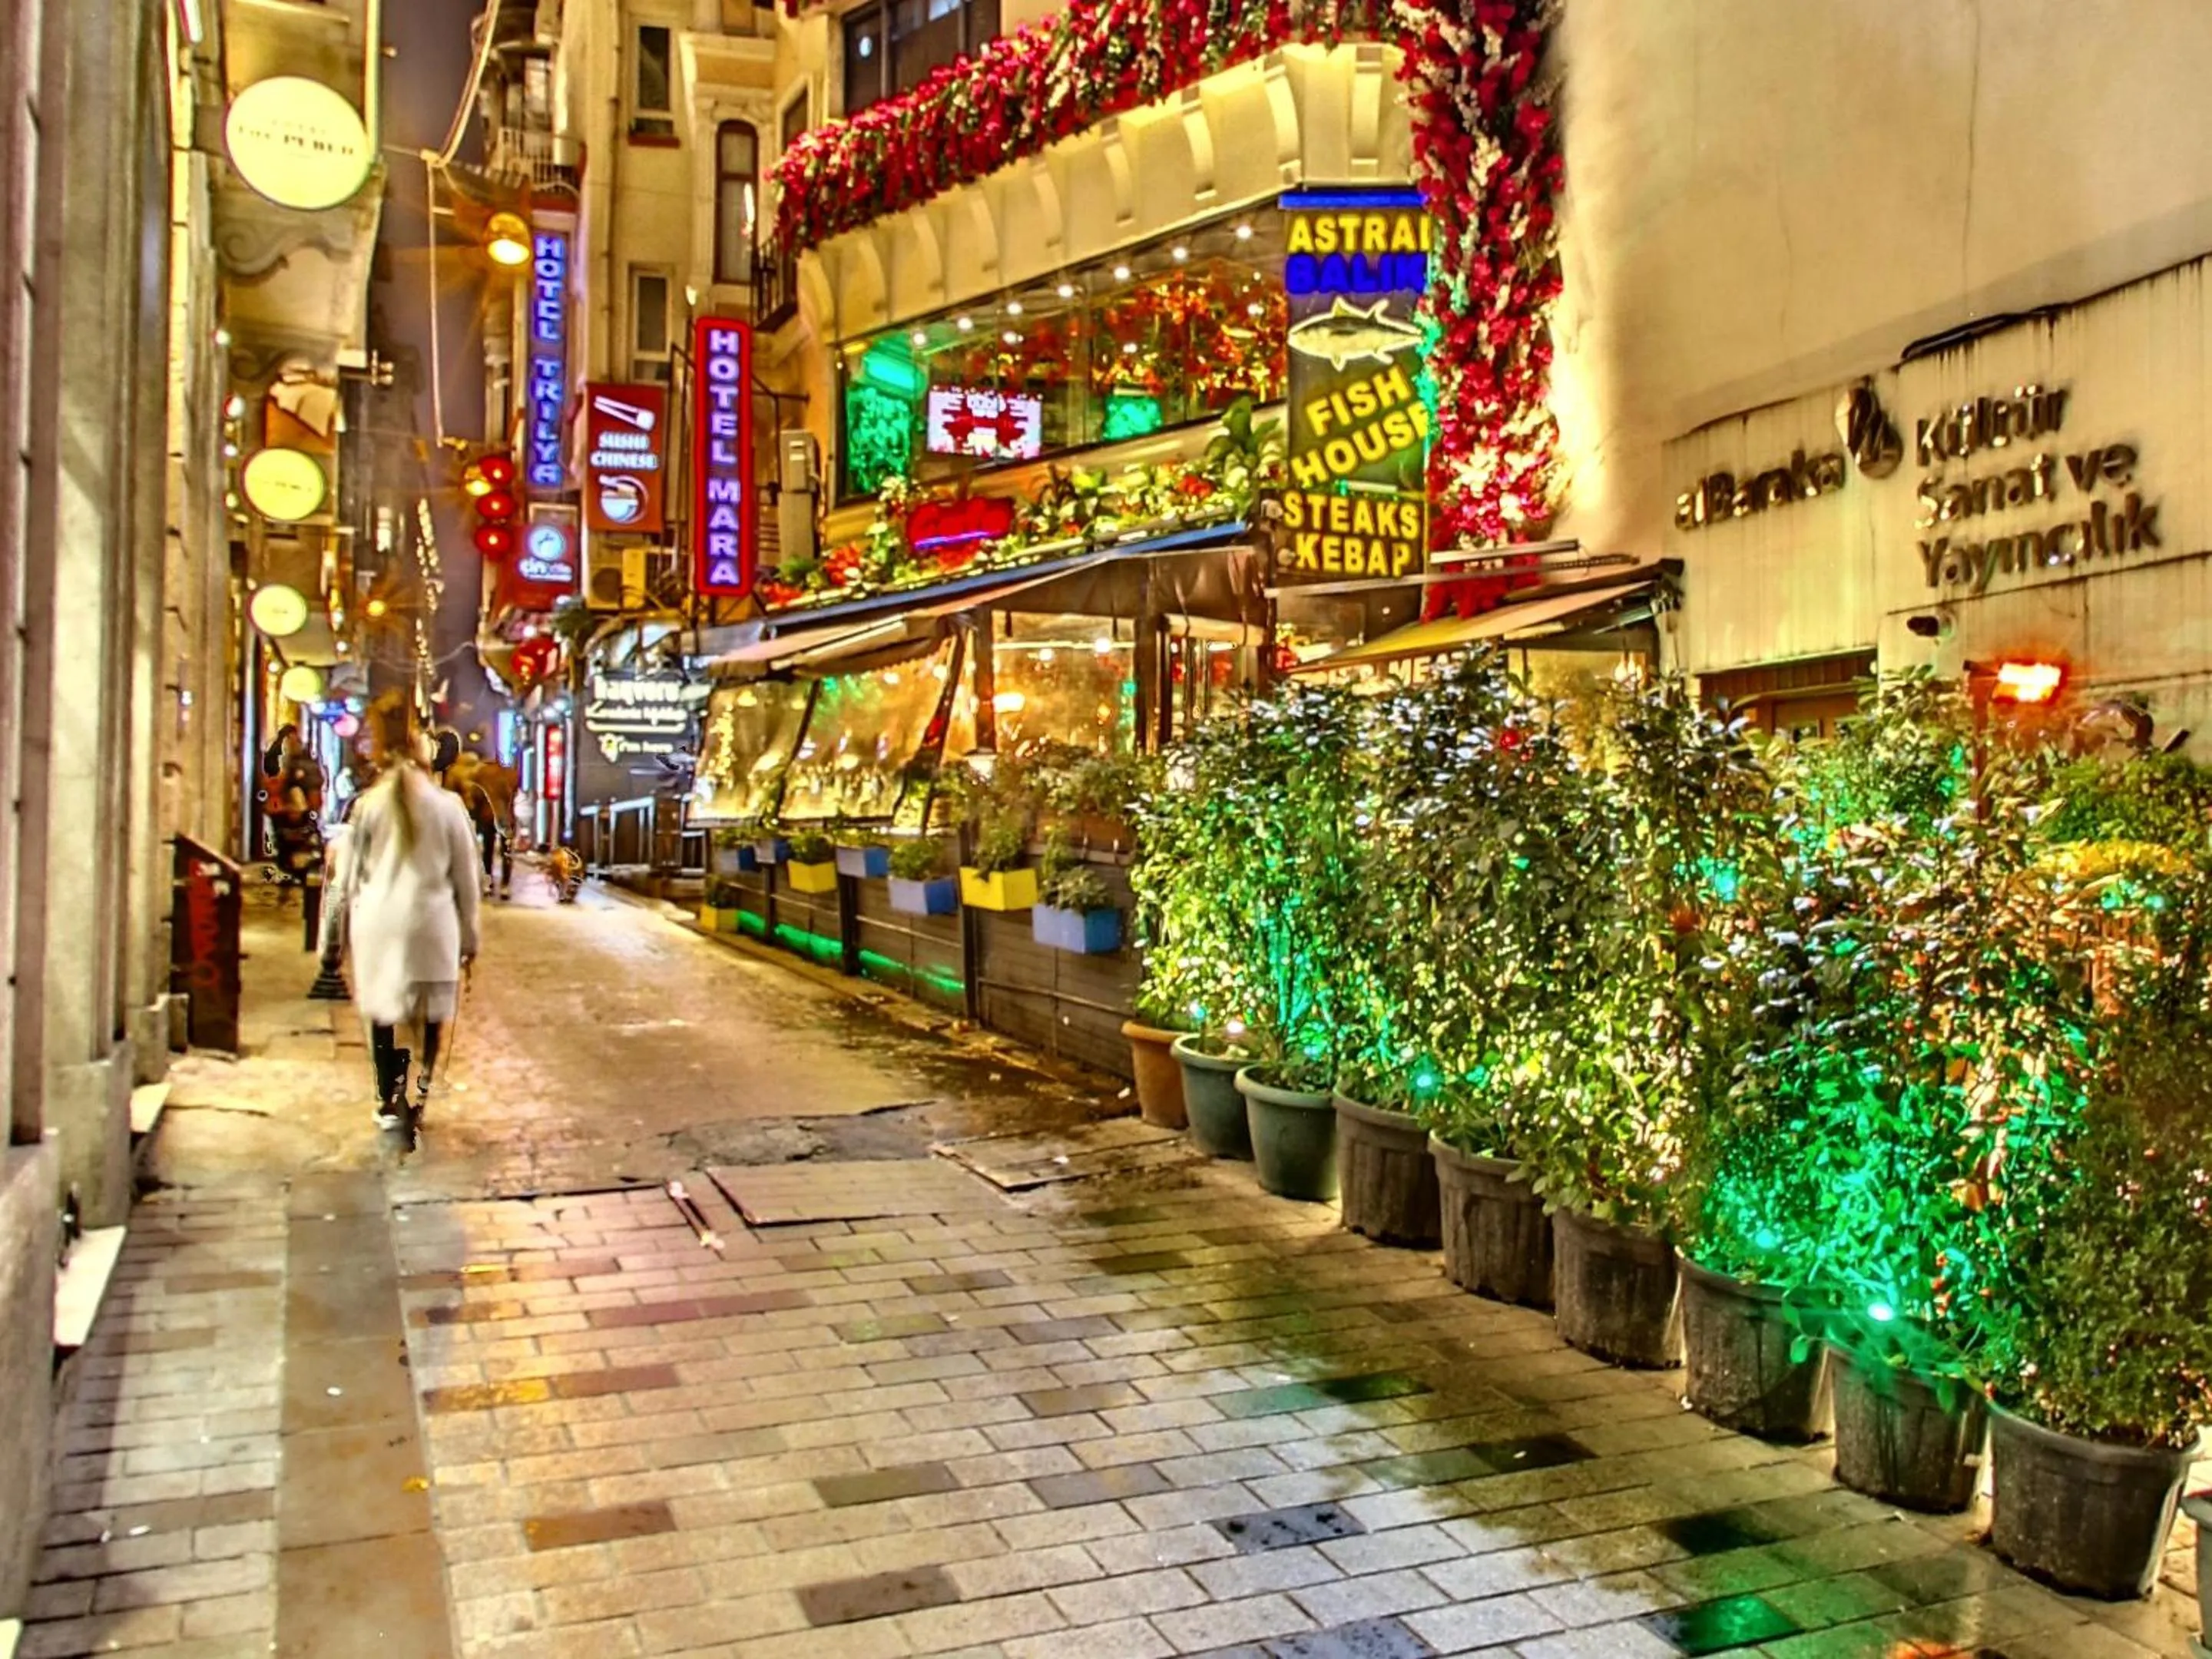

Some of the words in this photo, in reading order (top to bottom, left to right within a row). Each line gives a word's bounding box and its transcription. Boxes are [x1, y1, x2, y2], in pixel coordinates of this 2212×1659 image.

[533, 235, 565, 342] HOTEL
[1286, 252, 1426, 294] BALIK
[708, 328, 740, 465] HOTEL
[1306, 364, 1411, 437] FISH
[1283, 491, 1419, 539] STEAKS
[1914, 453, 2058, 530] Sanat
[2065, 443, 2138, 494] ve
[708, 478, 742, 585] MARA
[1294, 532, 1411, 577] KEBAP
